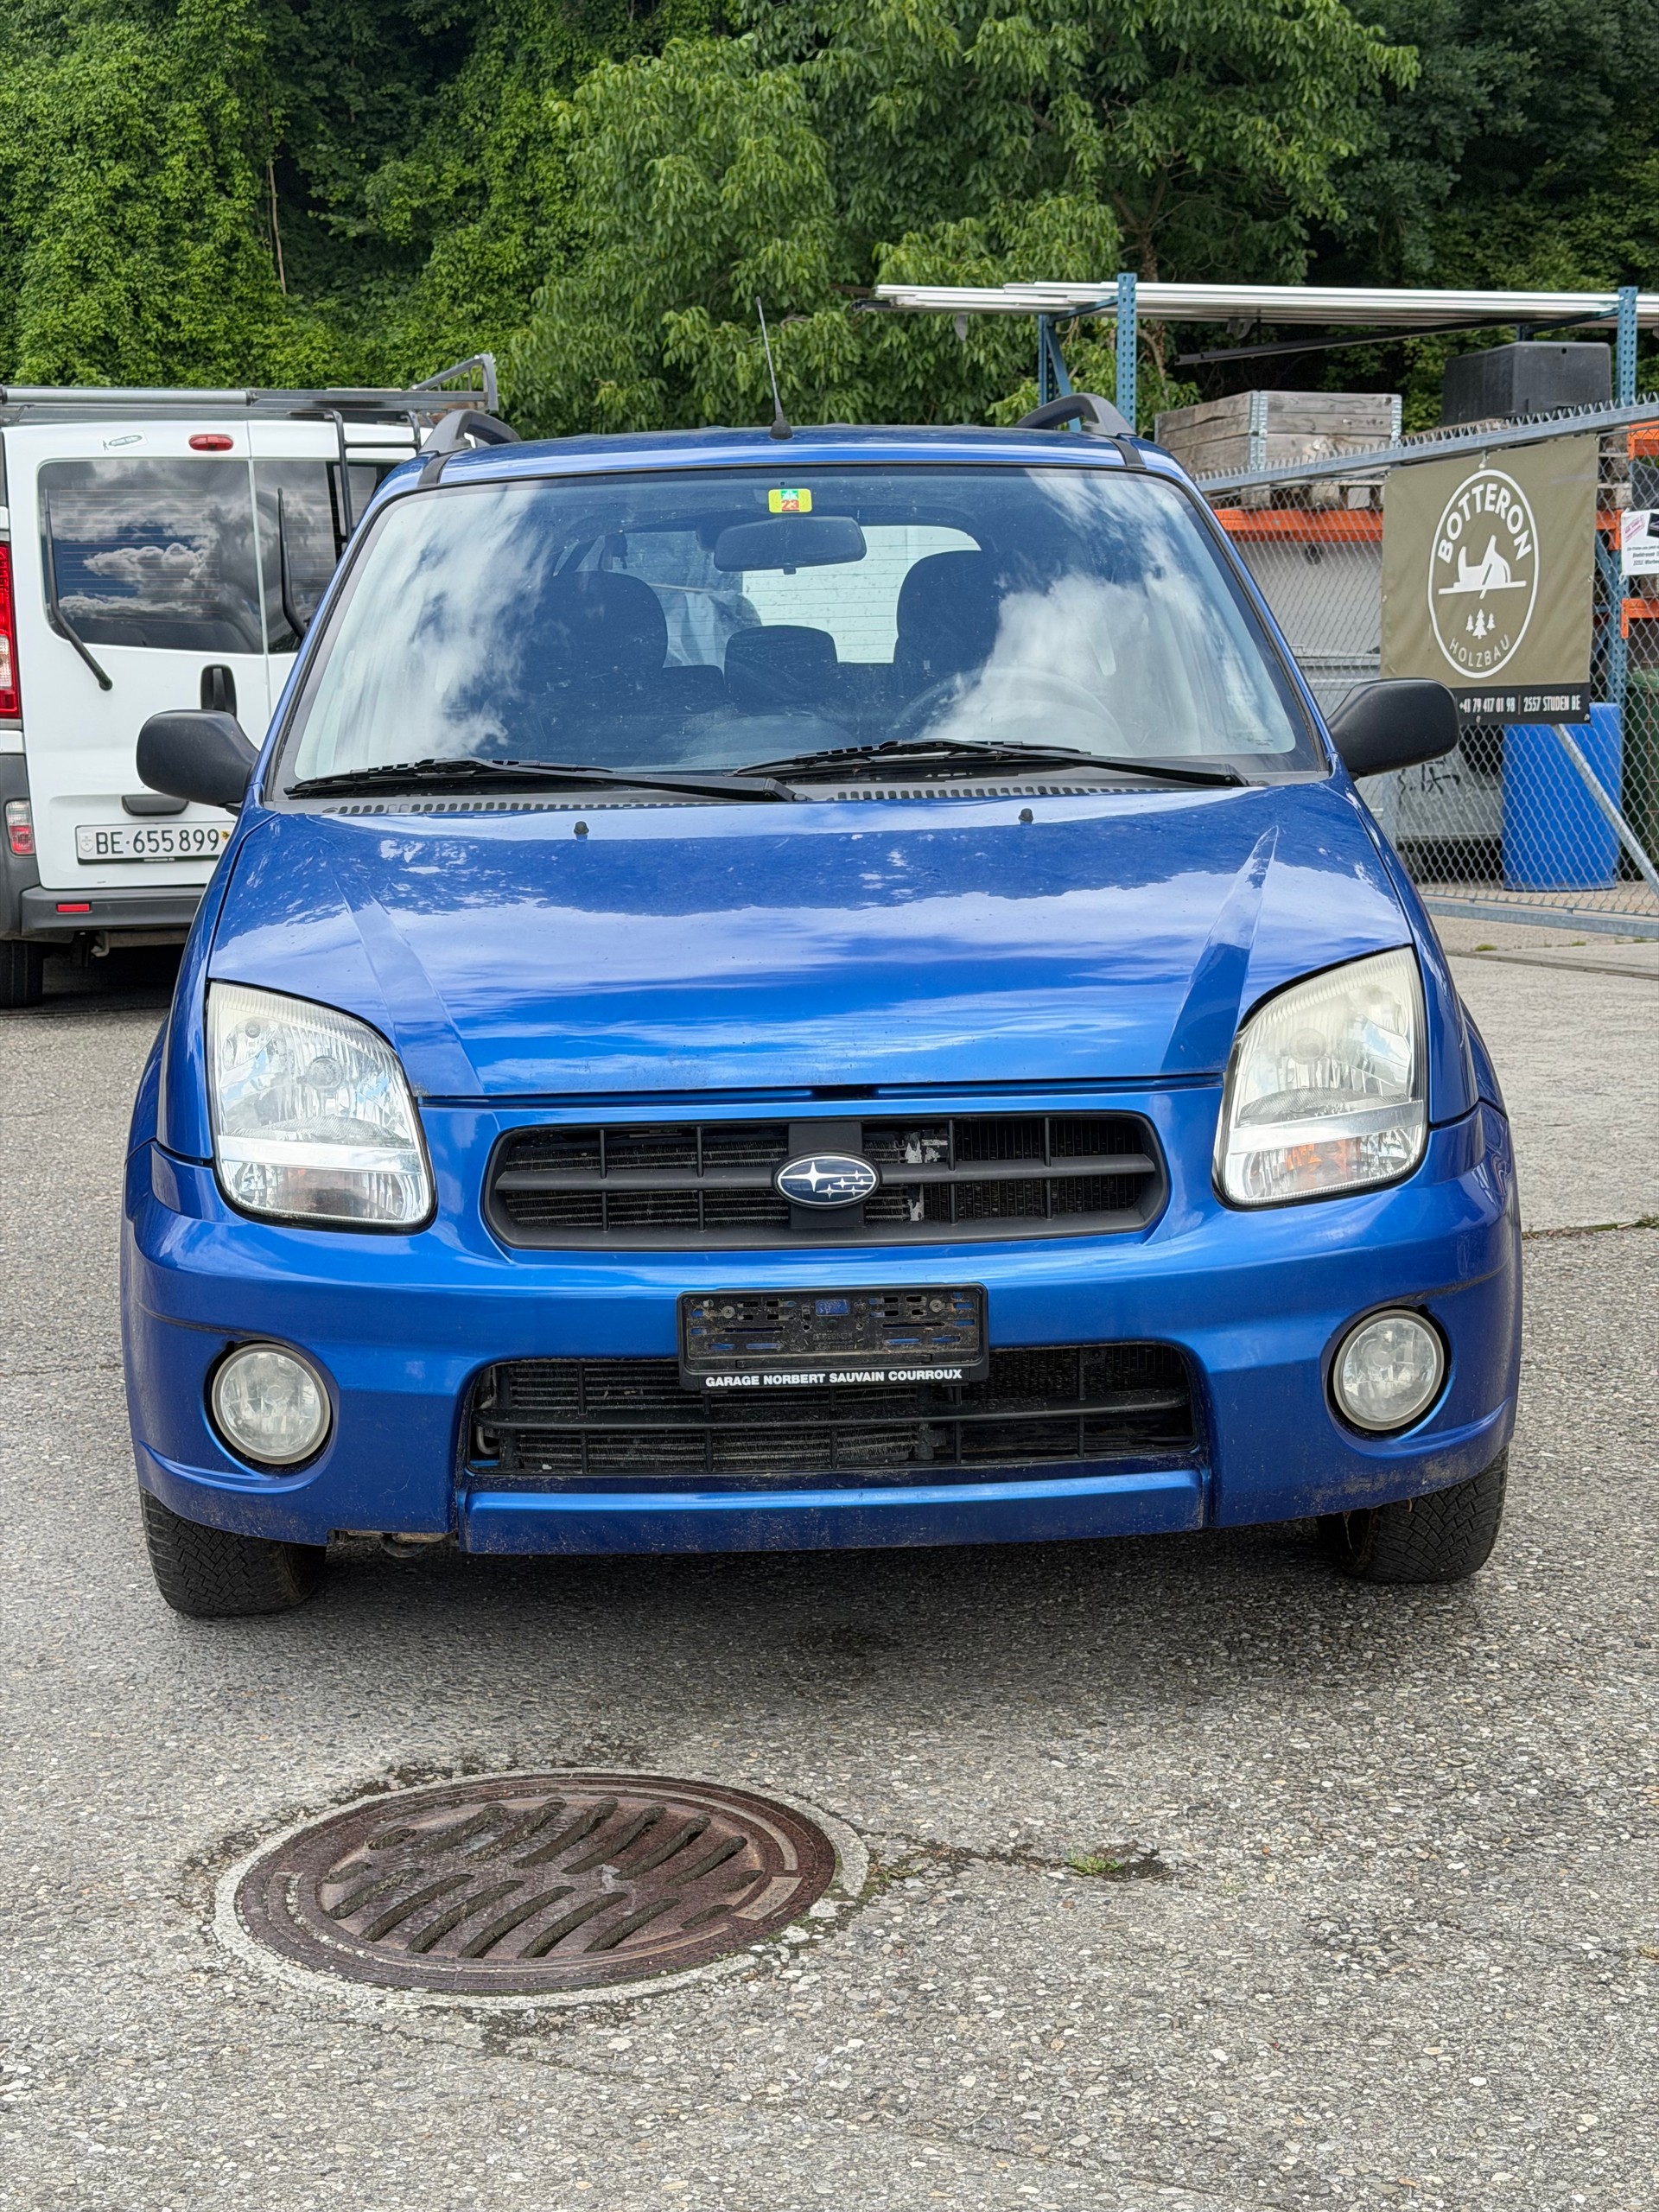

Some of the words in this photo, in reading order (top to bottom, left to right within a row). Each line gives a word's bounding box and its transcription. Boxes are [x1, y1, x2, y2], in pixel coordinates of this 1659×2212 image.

[781, 499, 799, 510] 23
[1437, 483, 1532, 563] BOTTERON
[1449, 634, 1510, 668] HOLZBAU
[1459, 698, 1471, 713] +41
[1472, 697, 1482, 713] 79
[1483, 697, 1496, 713] 417
[1496, 696, 1504, 713] 01
[1506, 696, 1516, 712] 98
[1523, 696, 1541, 712] 2557
[1542, 695, 1570, 712] STUDEN
[1571, 695, 1581, 711] BE
[705, 1375, 760, 1388] GARAGE
[763, 1373, 826, 1386] NORBERT
[829, 1371, 885, 1383] SAUVAIN
[888, 1369, 963, 1382] COURROUX
